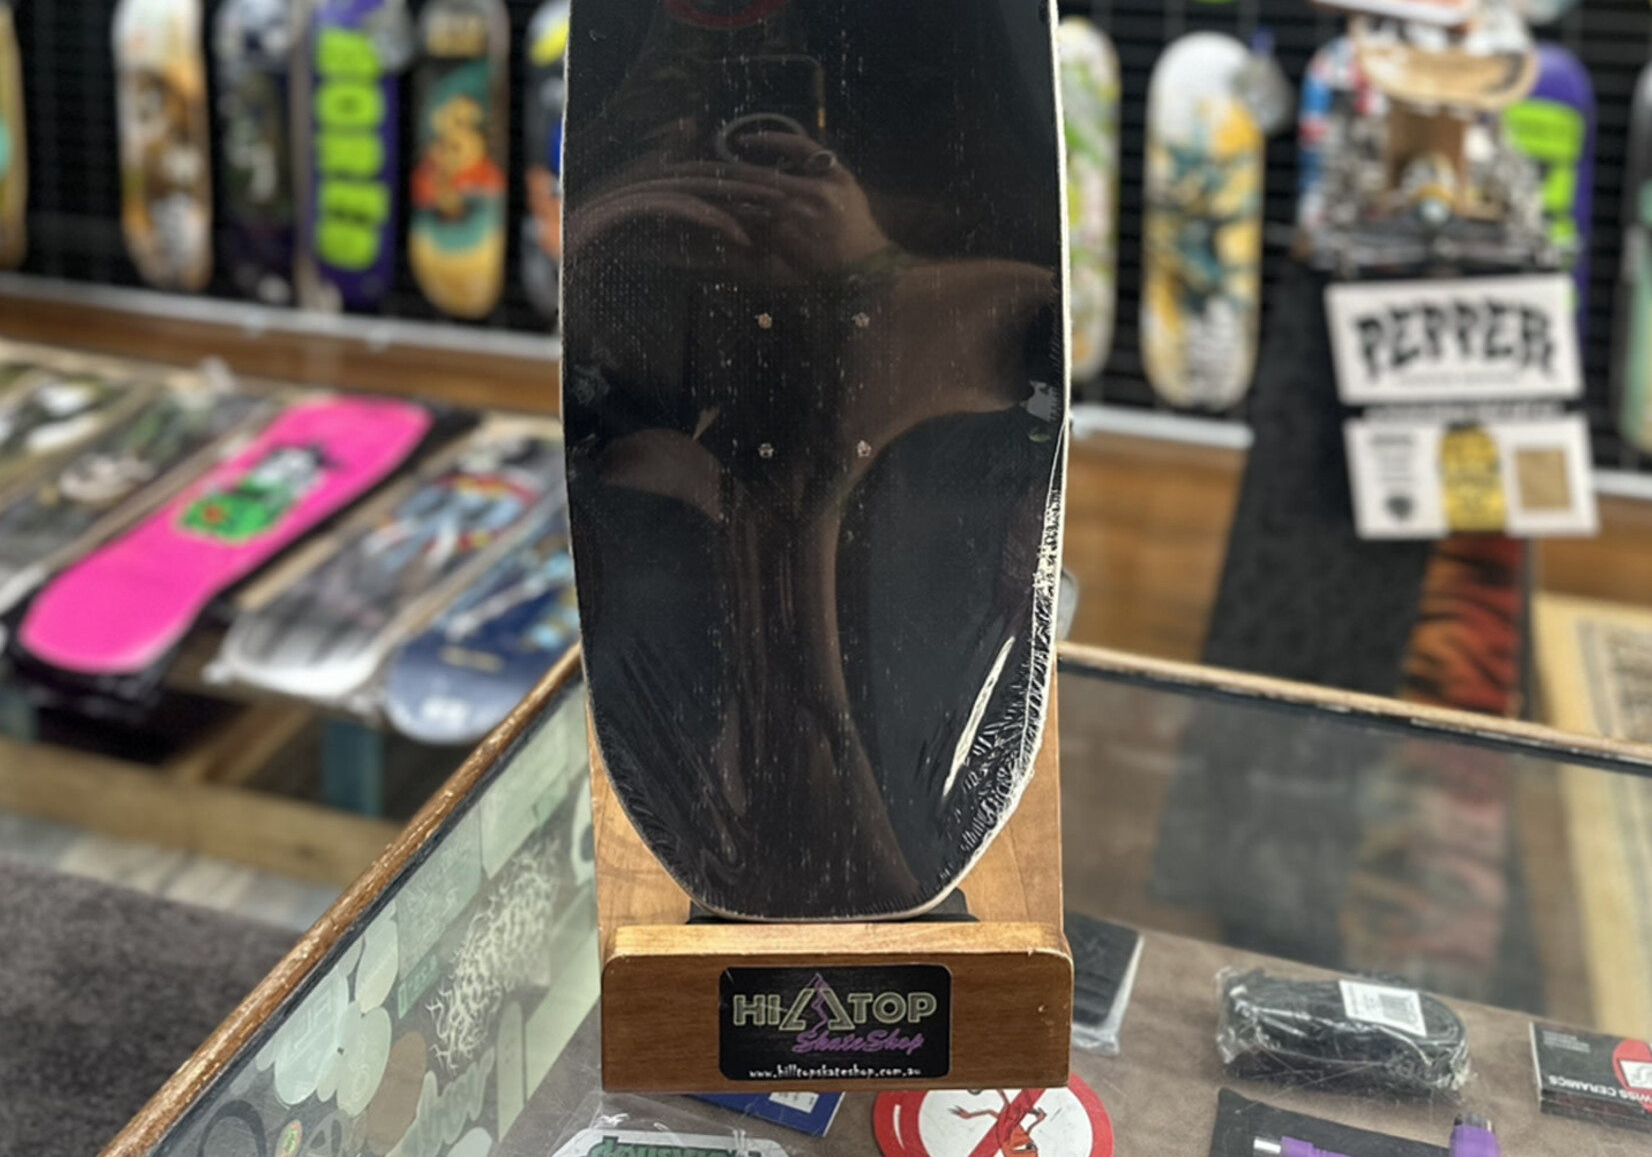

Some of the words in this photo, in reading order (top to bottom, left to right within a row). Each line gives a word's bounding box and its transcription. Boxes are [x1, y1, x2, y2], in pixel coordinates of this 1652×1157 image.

[1357, 299, 1554, 379] PEPPER
[749, 1064, 921, 1078] www.hilltopskateshop.com.au
[1548, 1075, 1617, 1097] CERAMICS
